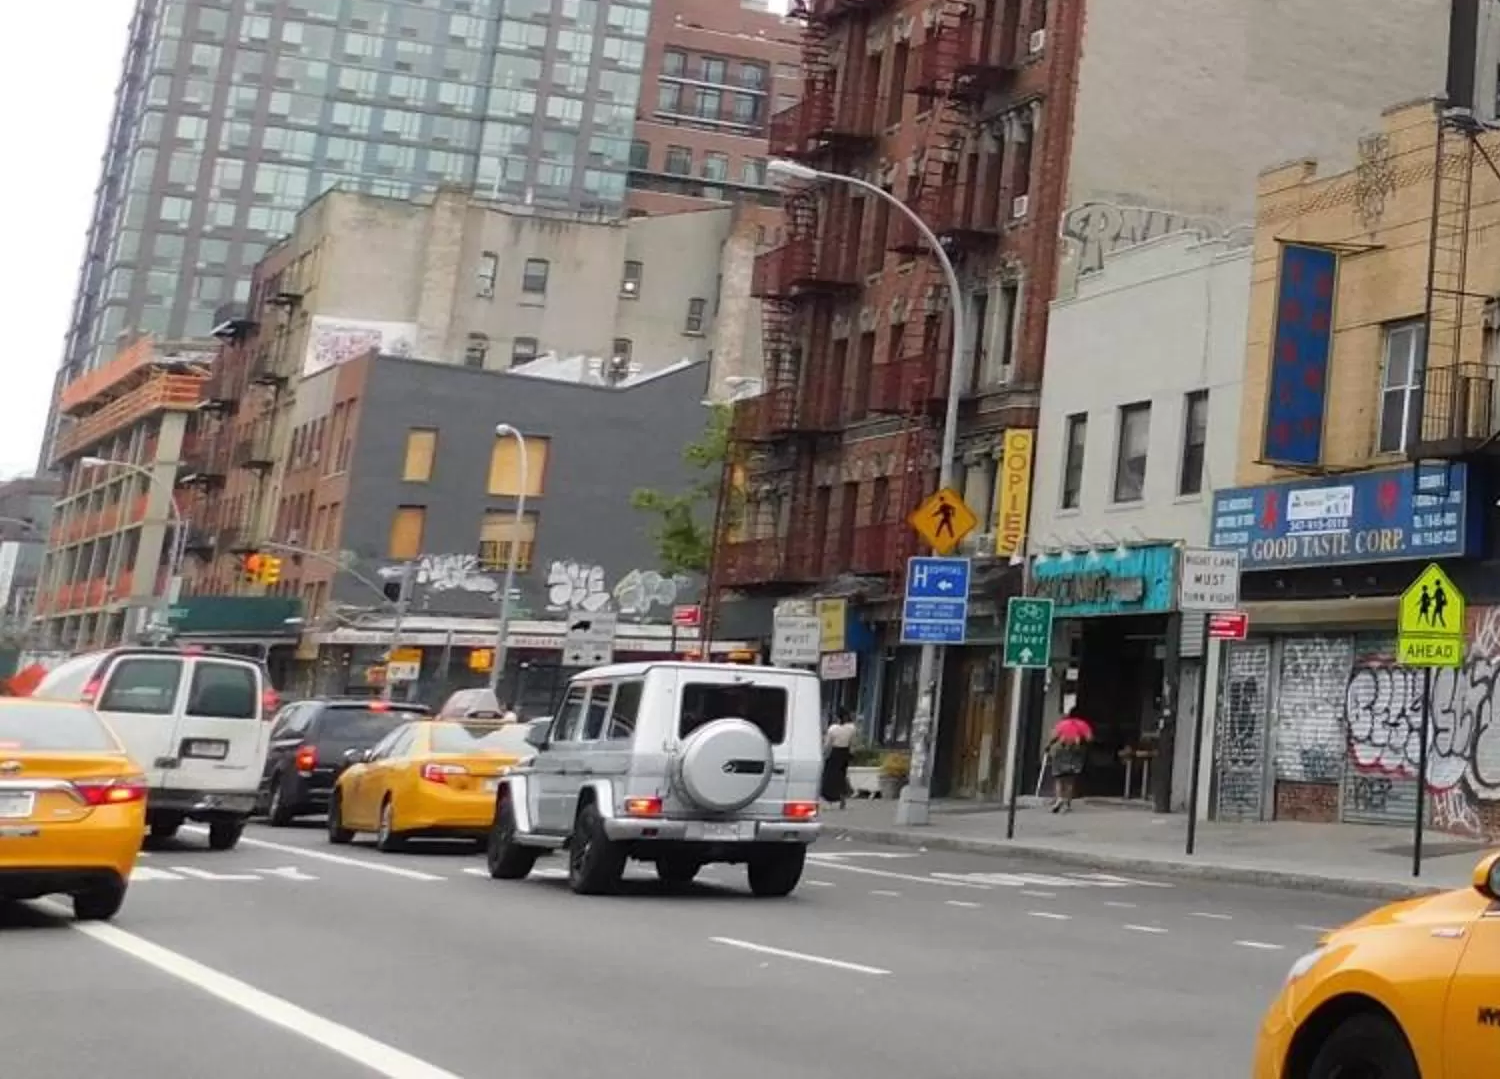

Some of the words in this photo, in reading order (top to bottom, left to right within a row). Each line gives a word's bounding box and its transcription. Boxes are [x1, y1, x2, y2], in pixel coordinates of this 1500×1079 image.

[1001, 432, 1029, 552] COPIES
[1252, 536, 1297, 561] GOOD
[1302, 532, 1351, 558] TASTE
[1355, 528, 1406, 553] CORP.
[1194, 573, 1226, 586] MUST
[1013, 622, 1043, 632] East
[1010, 633, 1045, 644] River
[1407, 643, 1453, 658] AHEAD
